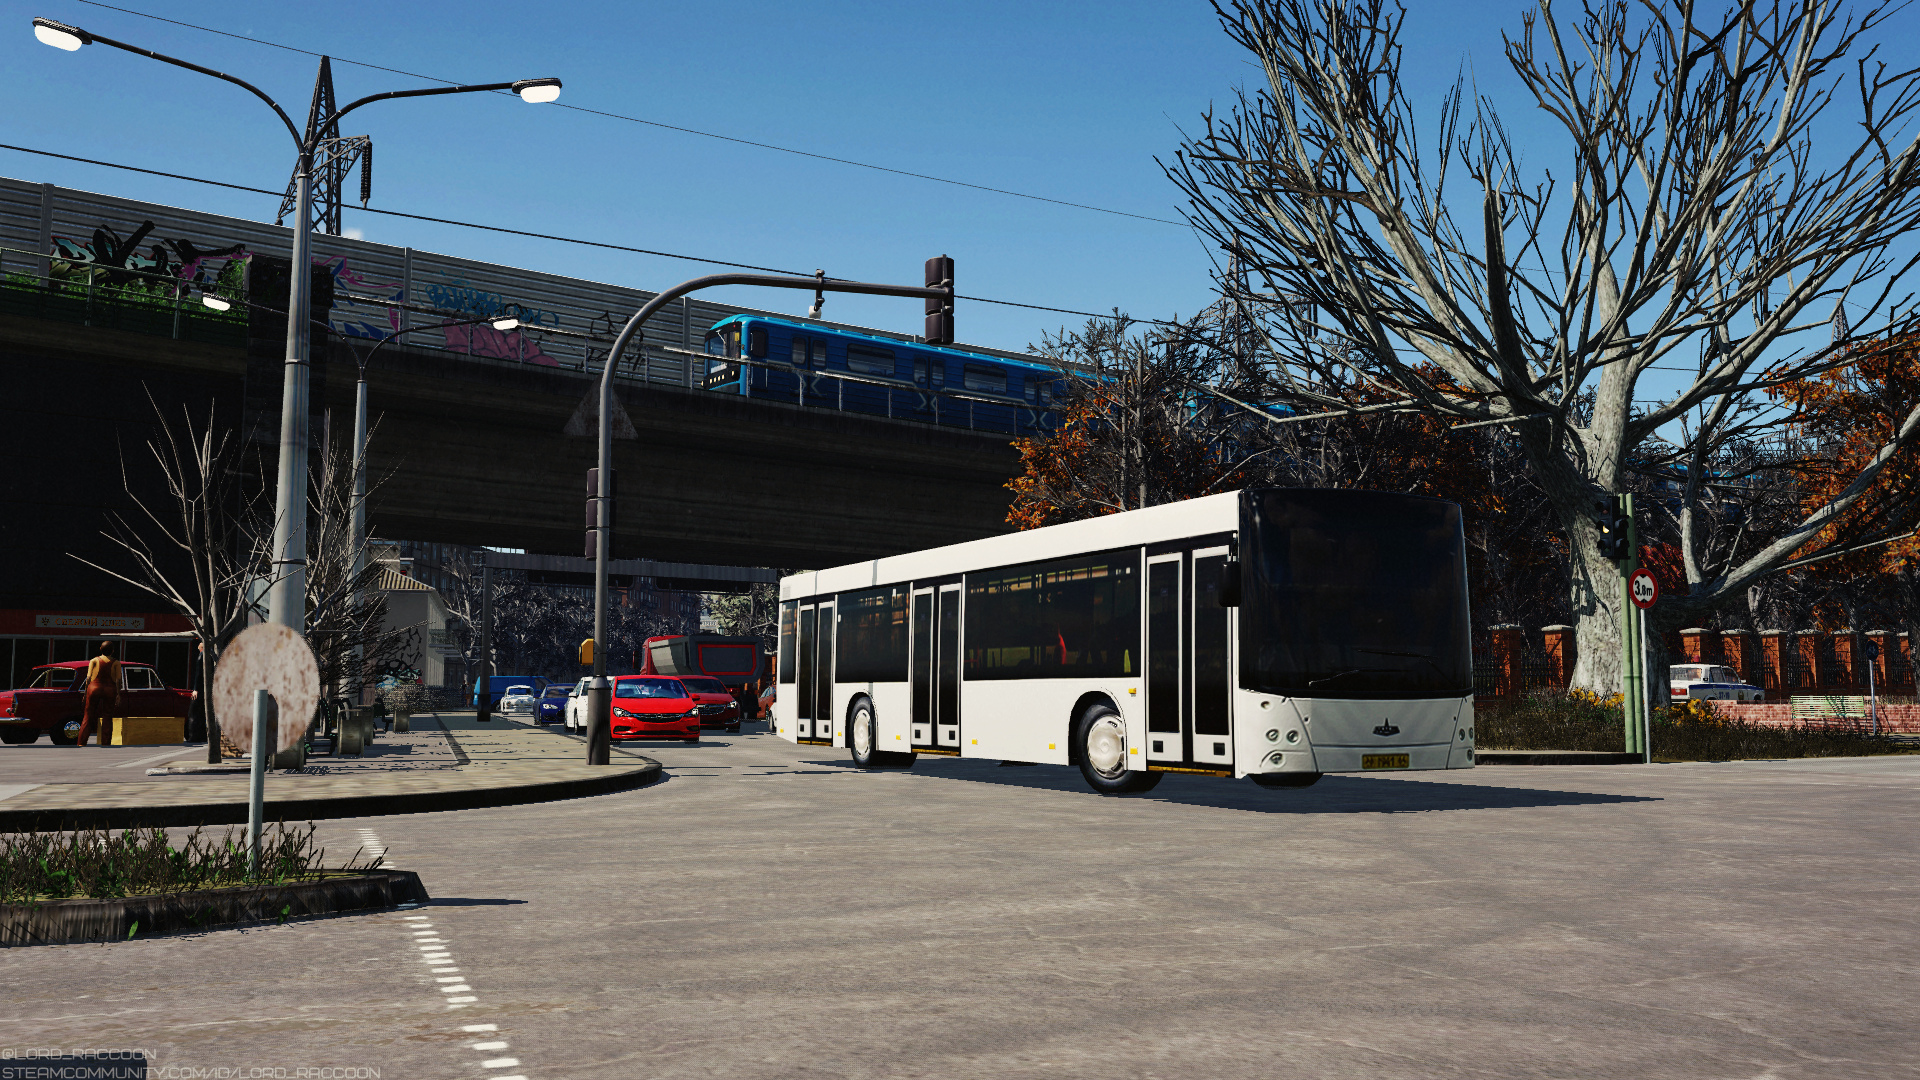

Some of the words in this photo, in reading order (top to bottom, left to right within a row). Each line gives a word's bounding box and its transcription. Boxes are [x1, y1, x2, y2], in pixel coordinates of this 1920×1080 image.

[1635, 580, 1653, 596] 3.8m
[55, 617, 98, 627] СВЕЖИЙ
[101, 618, 126, 627] ХЛЕБ
